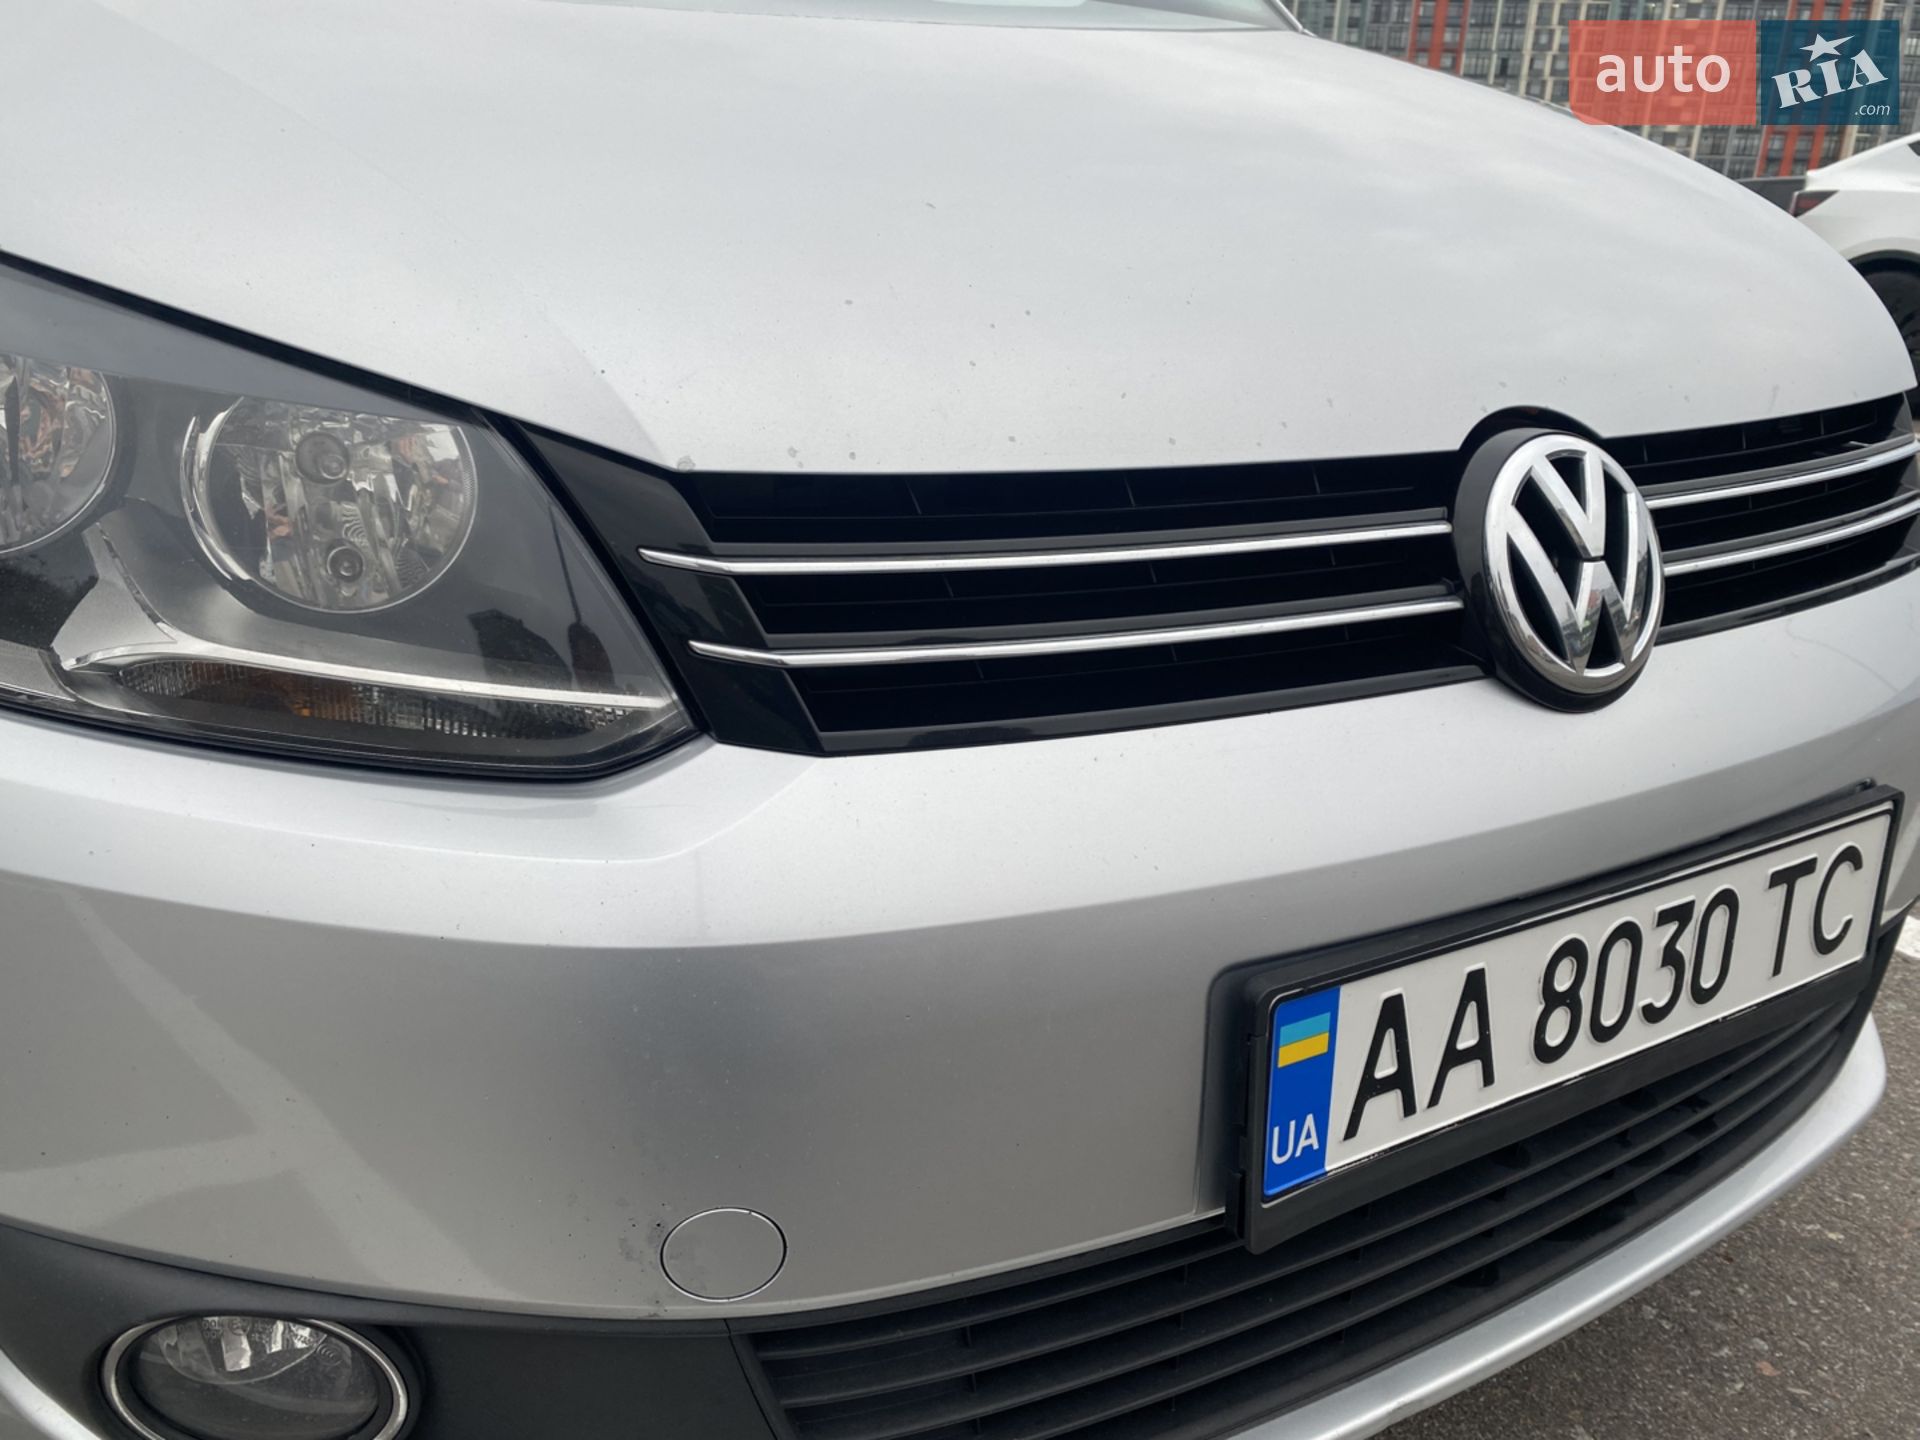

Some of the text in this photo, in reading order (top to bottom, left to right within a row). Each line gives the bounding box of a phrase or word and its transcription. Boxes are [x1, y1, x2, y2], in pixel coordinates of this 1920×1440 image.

[1342, 844, 1864, 1142] AA 8030 TC
[1271, 1113, 1320, 1165] UA
